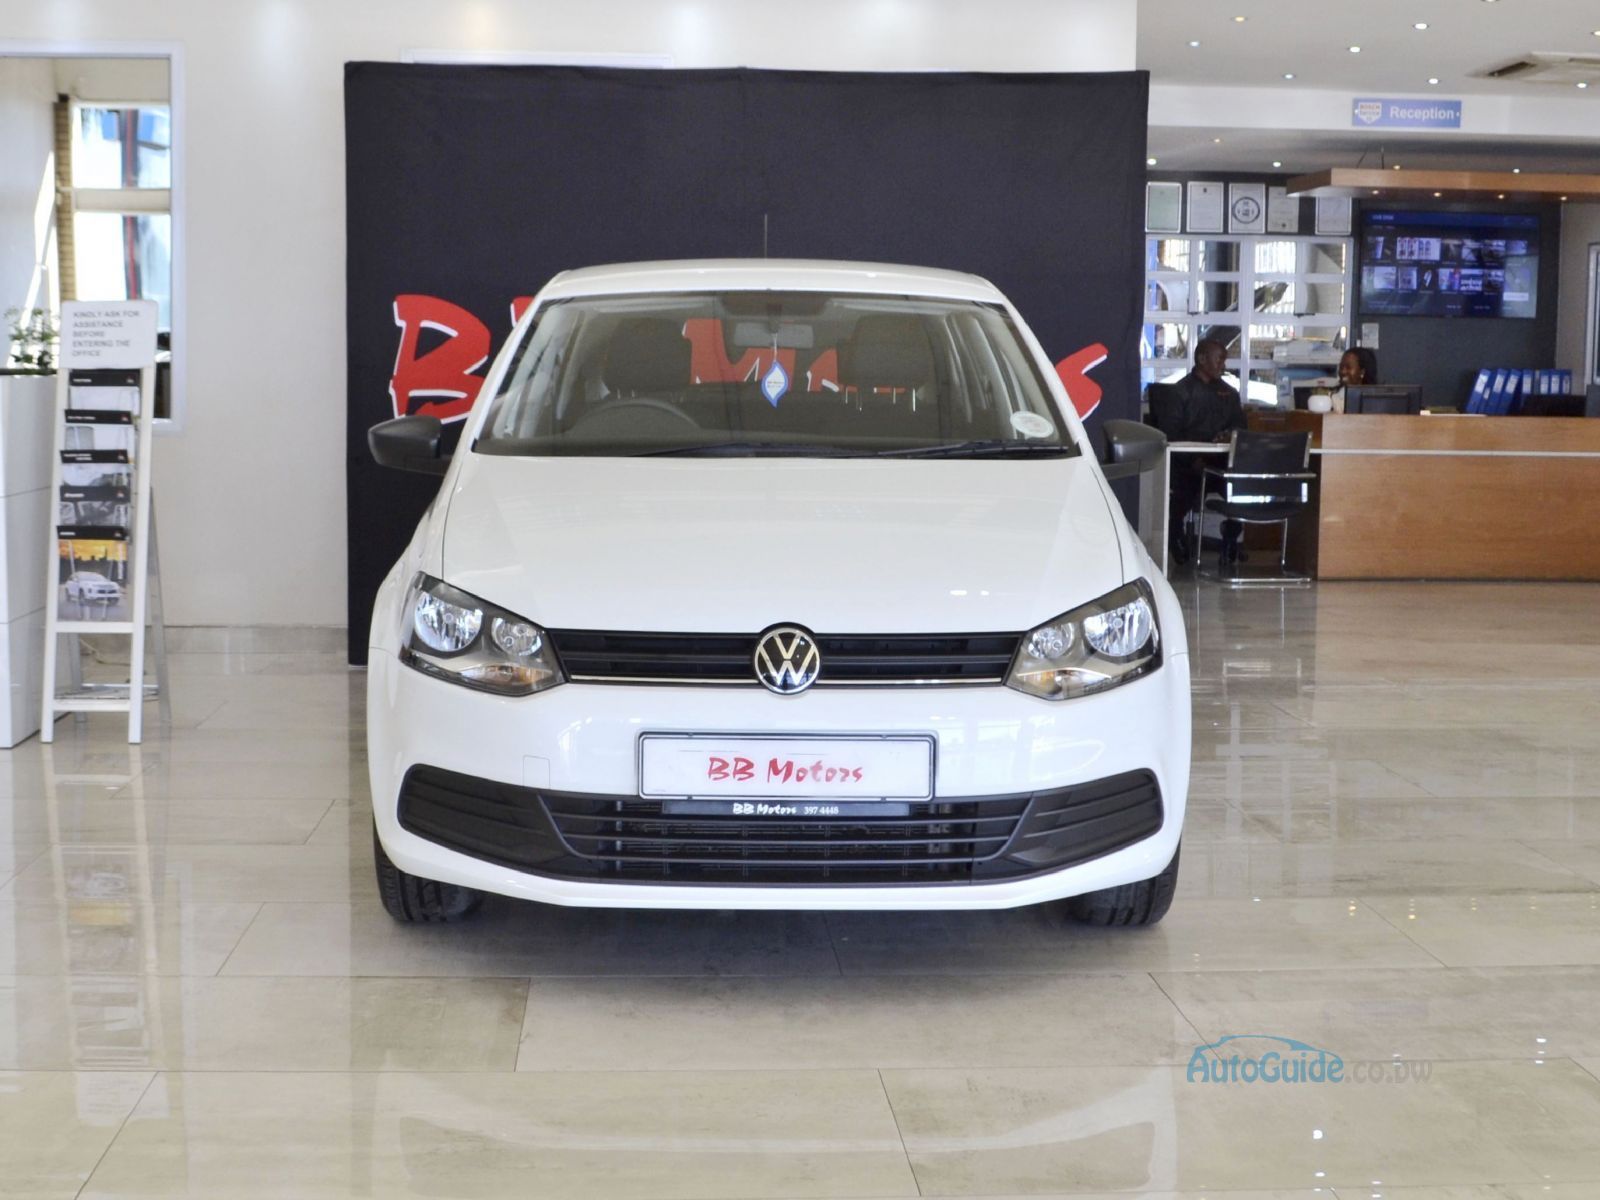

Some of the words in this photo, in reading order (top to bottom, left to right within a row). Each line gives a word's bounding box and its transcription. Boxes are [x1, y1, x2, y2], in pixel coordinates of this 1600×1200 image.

[1390, 106, 1454, 121] Reception
[389, 294, 535, 424] B
[707, 757, 755, 781] BB
[767, 758, 863, 783] Motors
[733, 804, 754, 815] BB
[757, 804, 797, 815] Motors
[804, 806, 818, 815] 397
